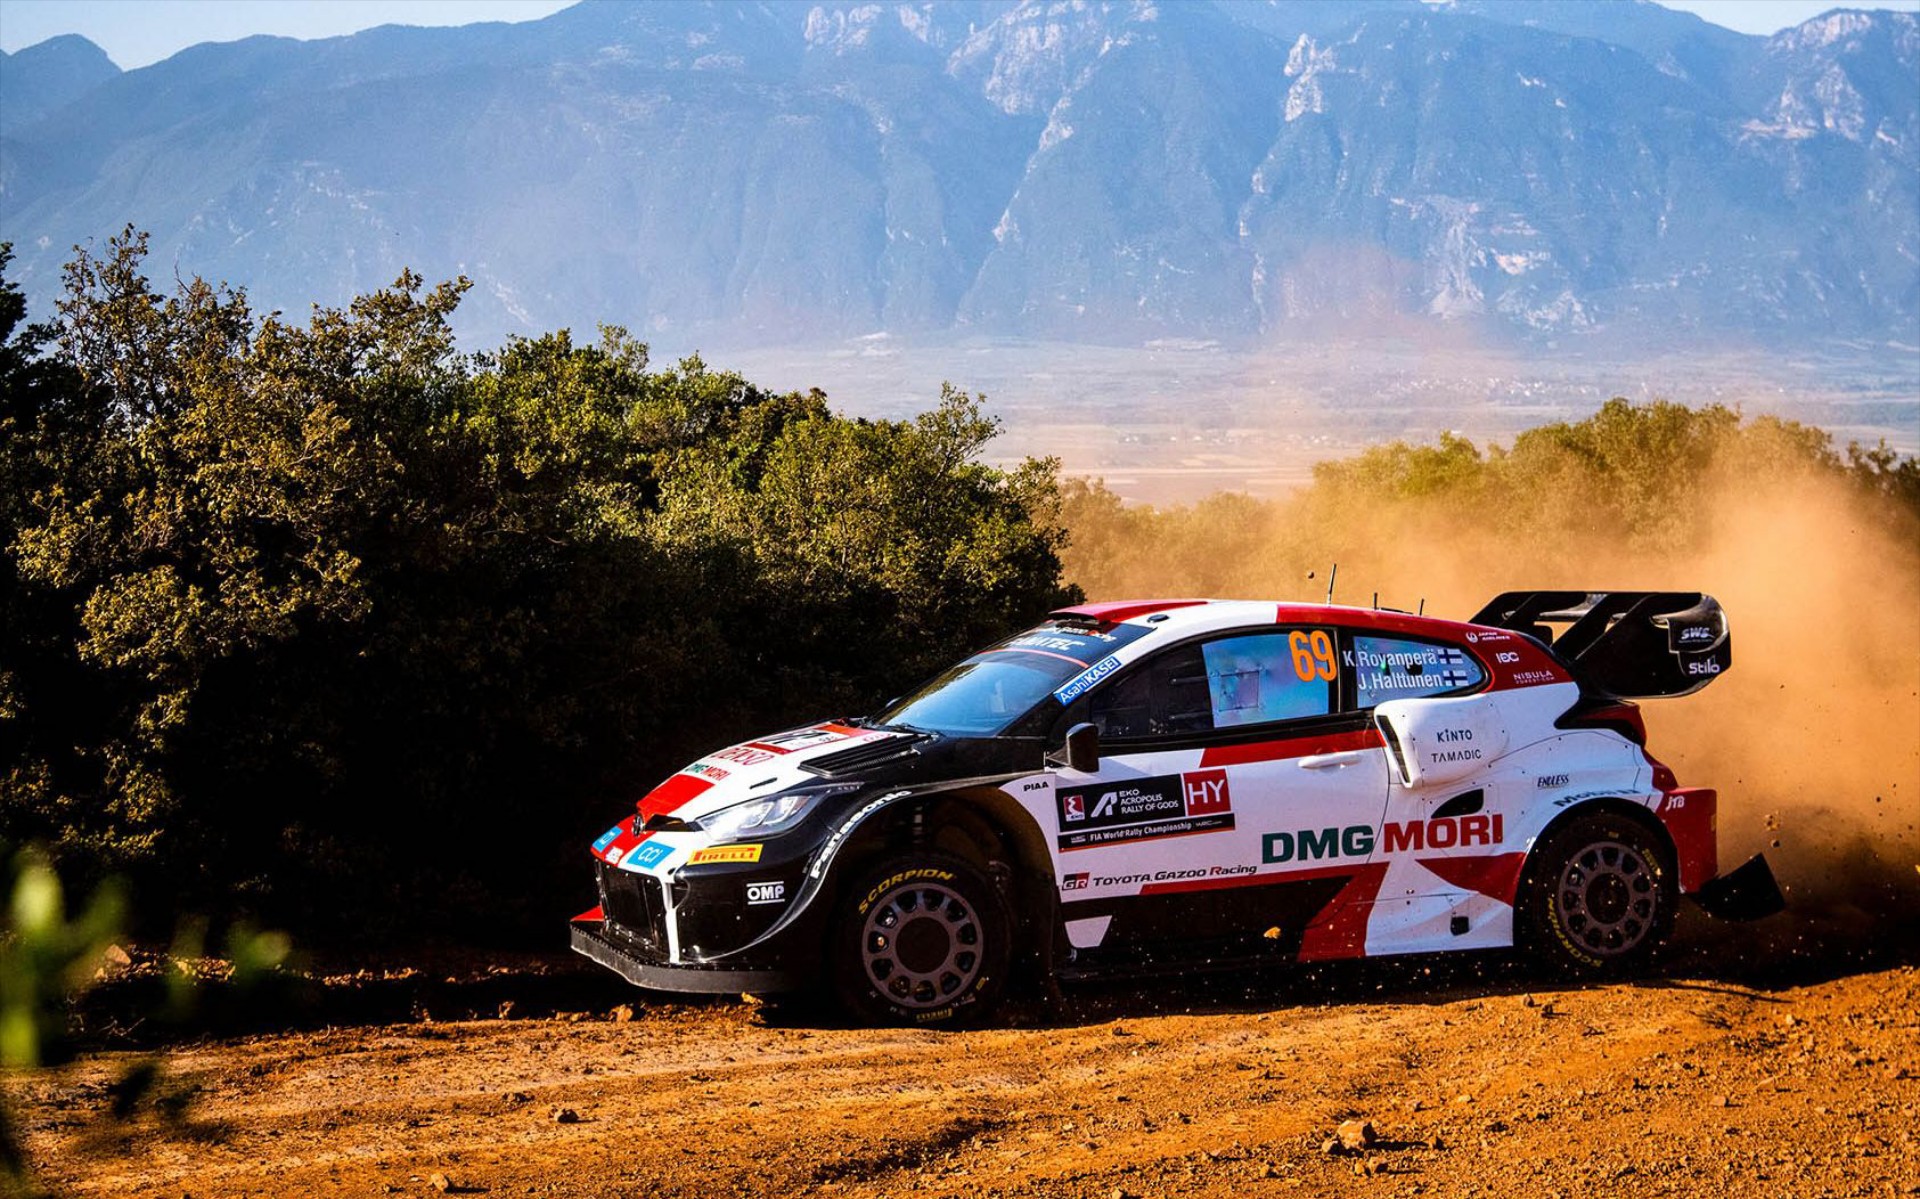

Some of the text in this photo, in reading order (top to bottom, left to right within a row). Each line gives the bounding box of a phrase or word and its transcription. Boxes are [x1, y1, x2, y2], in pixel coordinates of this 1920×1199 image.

[1289, 630, 1337, 682] 69
[1689, 658, 1720, 674] Stilo
[1059, 656, 1120, 704] AsahiKASEI
[1358, 673, 1443, 691] J.Halttunen
[1512, 670, 1553, 681] NISULA
[1431, 749, 1482, 764] TAMADIC
[1023, 781, 1049, 792] PIAA
[1537, 774, 1570, 788] ENDLESS
[1119, 788, 1140, 797] EKO
[1120, 794, 1163, 806] ACROPOLIS
[1187, 779, 1225, 806] HY
[1121, 800, 1179, 814] RALLY OF GODS
[810, 791, 912, 879] Panasonic
[1090, 821, 1192, 842] FIA World Rally Championship
[1262, 814, 1504, 864] DMG MORI
[693, 847, 757, 862] PIRELLI
[1062, 864, 1258, 891] GR TOYOTA GAZOO Racing
[747, 885, 785, 900] OMP
[858, 868, 954, 914] SCORPION
